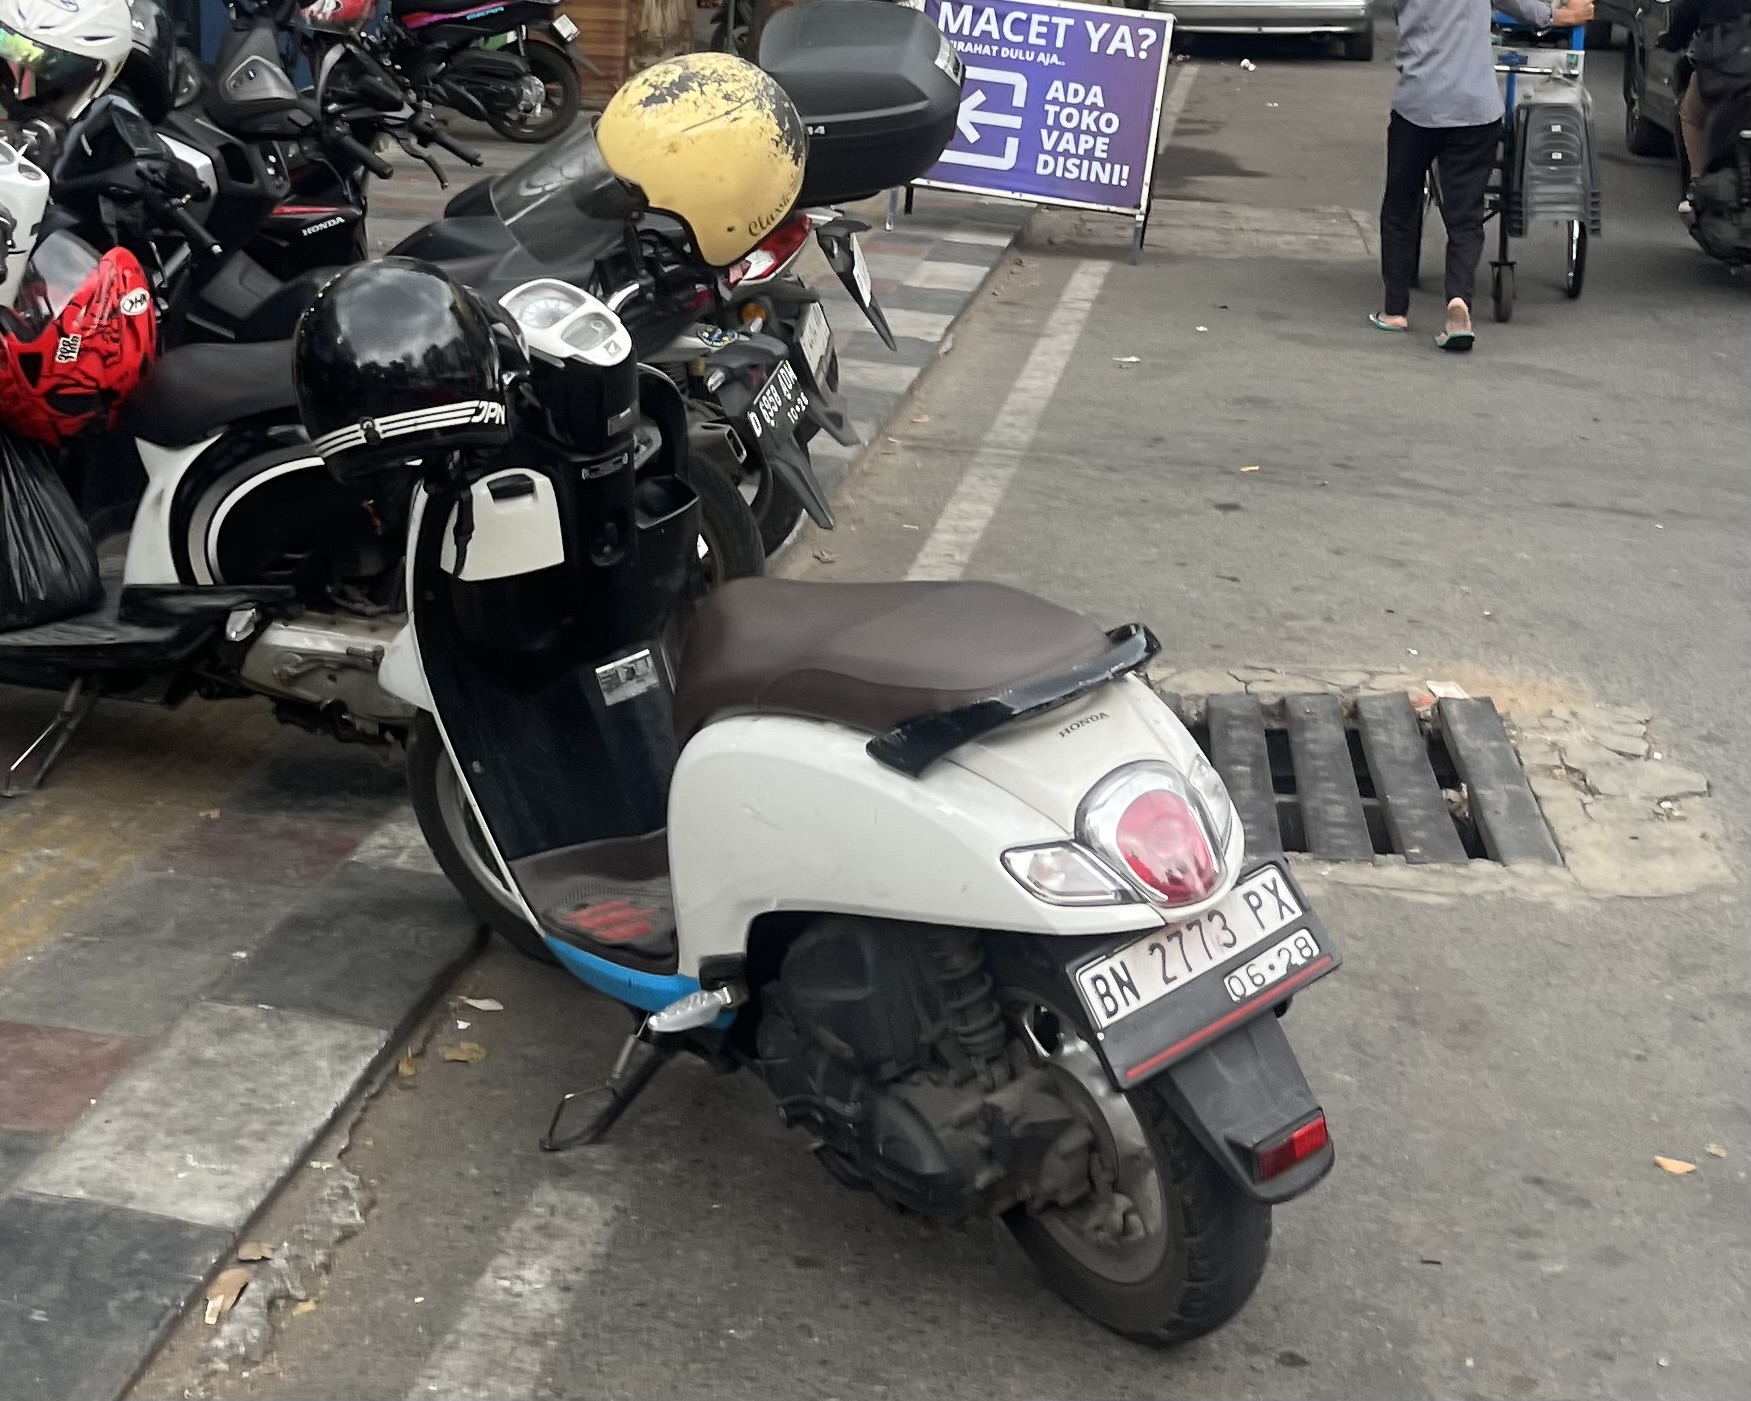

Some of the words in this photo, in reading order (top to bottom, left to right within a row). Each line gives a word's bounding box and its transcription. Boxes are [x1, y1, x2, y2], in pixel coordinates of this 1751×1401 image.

[938, 2, 1074, 48] MACET
[1085, 20, 1157, 59] YA?
[1001, 47, 1035, 61] DULU
[1046, 80, 1105, 108] ADA
[1044, 104, 1120, 134] TOKO
[1040, 129, 1110, 158] VAPE
[1036, 153, 1130, 187] DISINI!
[302, 216, 345, 236] HONDA
[747, 411, 762, 438] D
[1058, 712, 1110, 738] HONDA
[1091, 960, 1141, 1018] BN
[1149, 909, 1237, 985] 2773
[1243, 877, 1296, 930] PX
